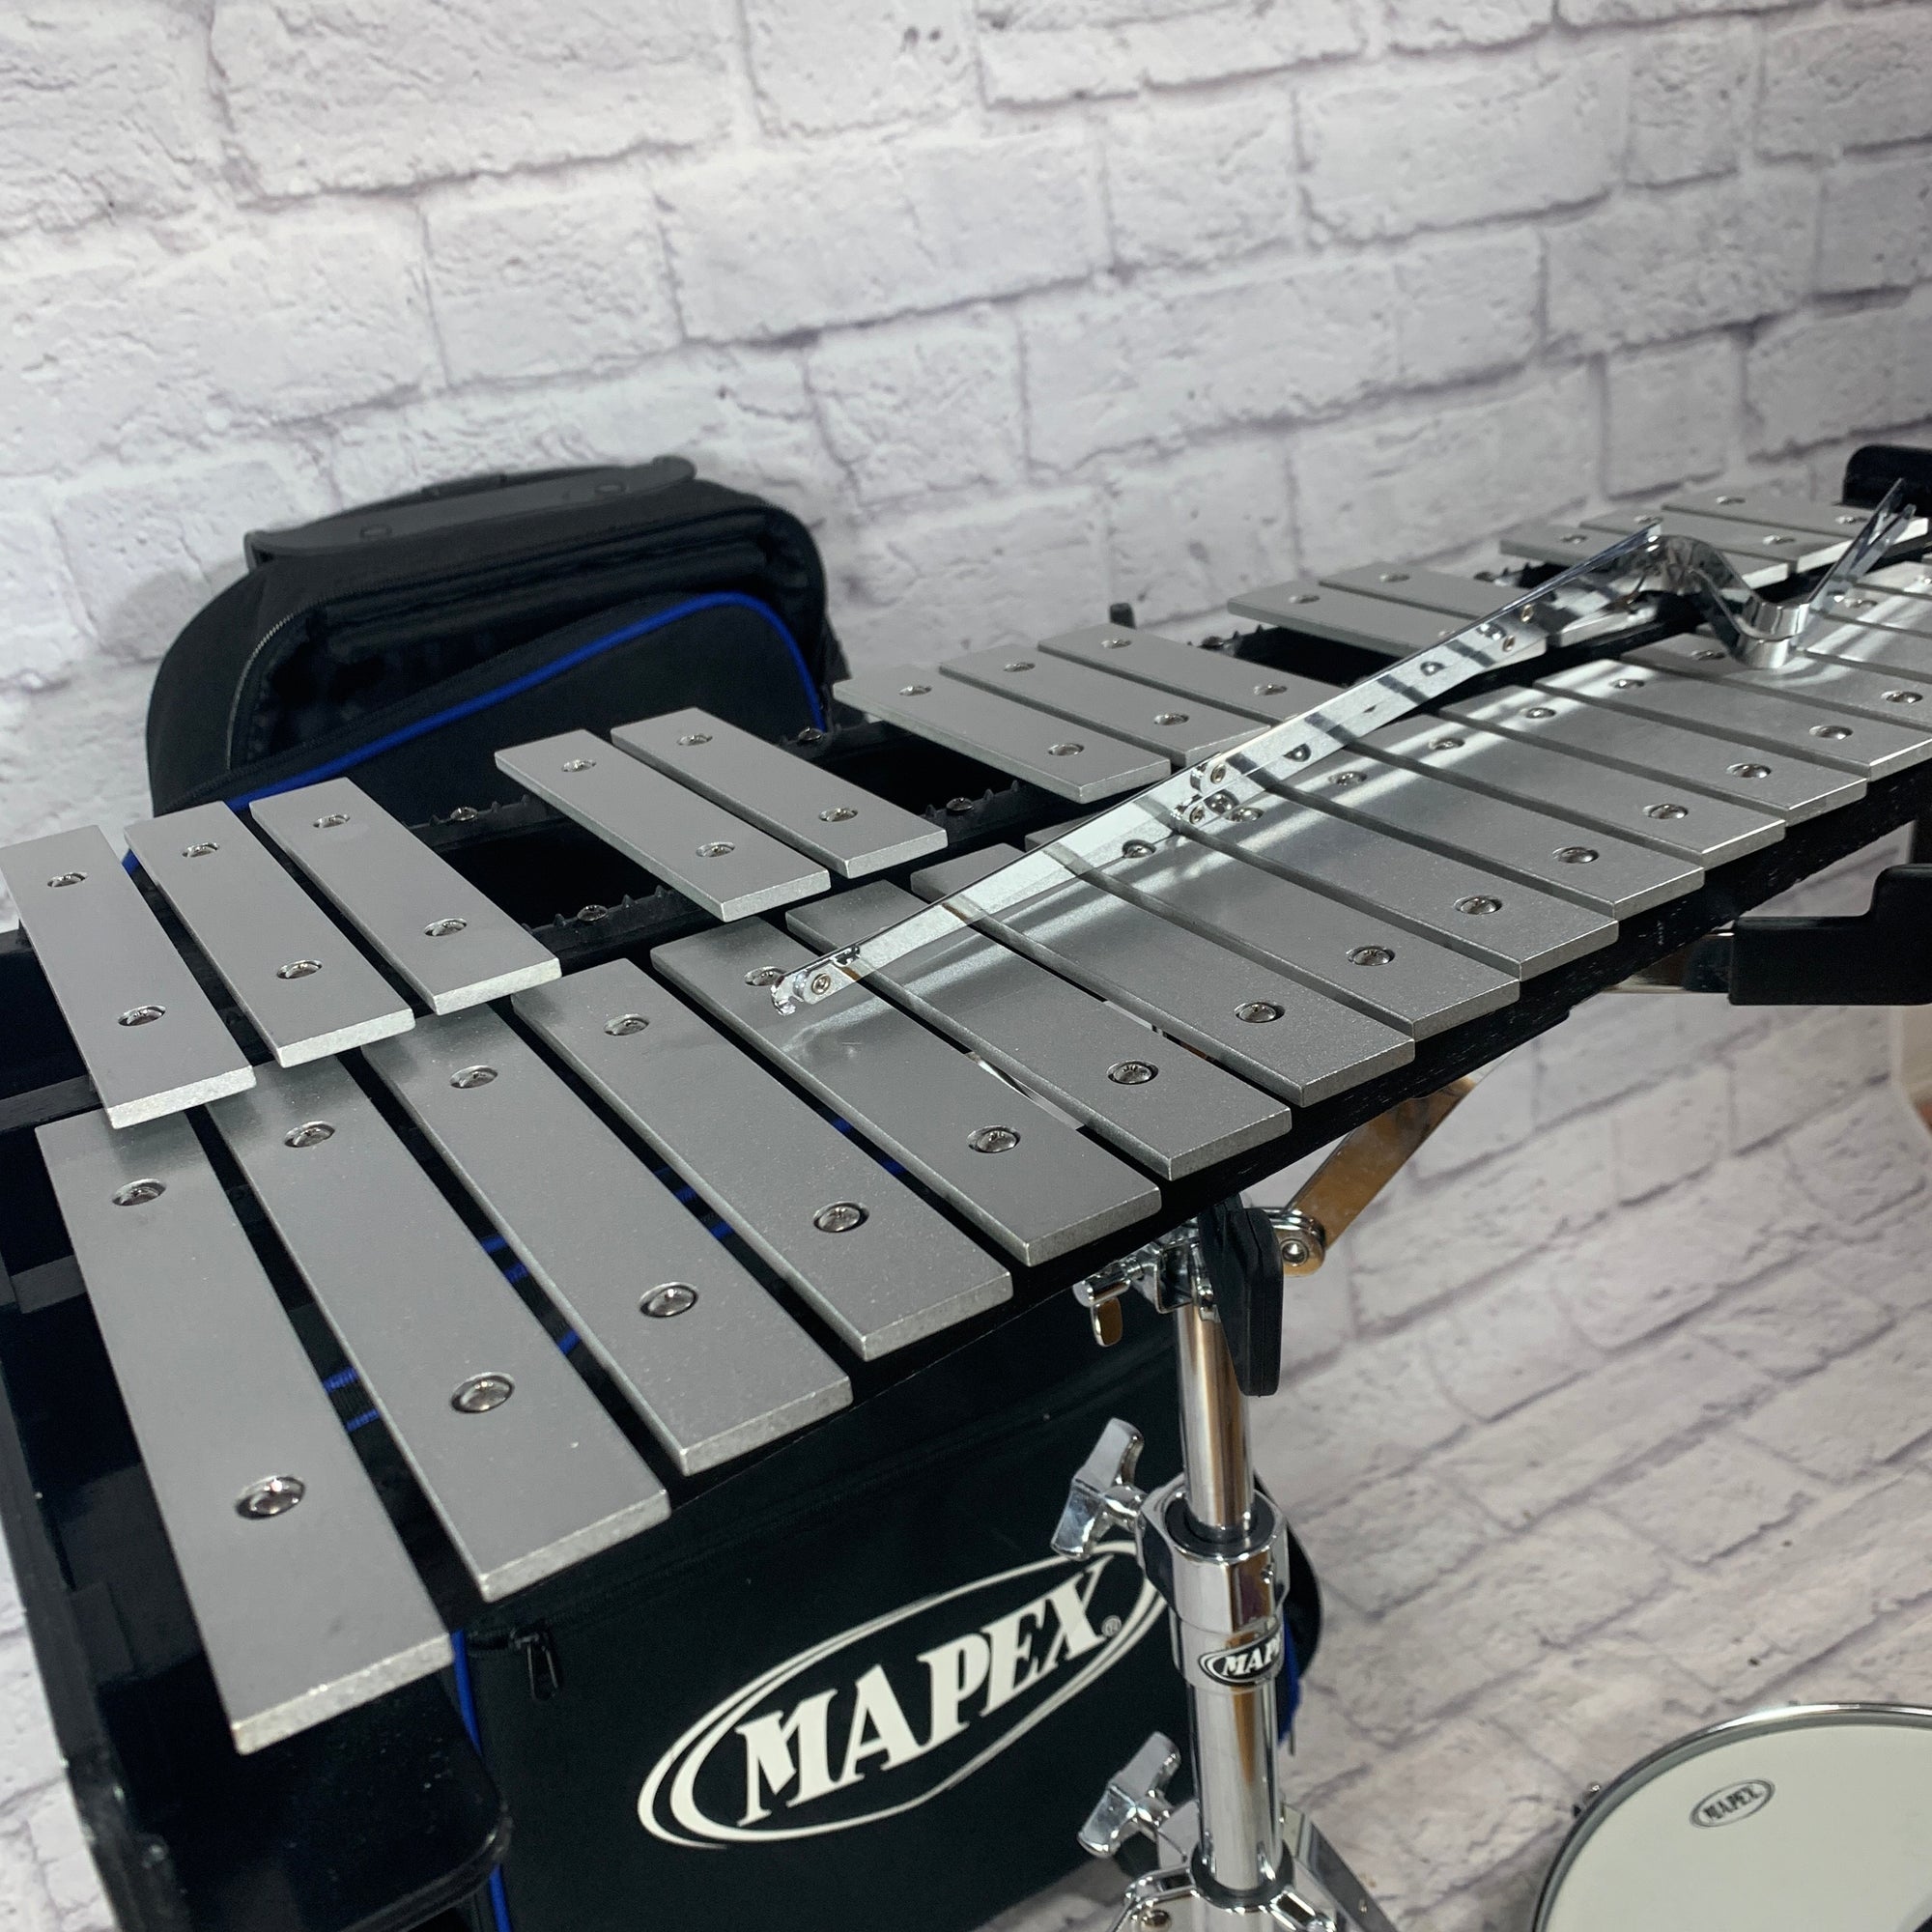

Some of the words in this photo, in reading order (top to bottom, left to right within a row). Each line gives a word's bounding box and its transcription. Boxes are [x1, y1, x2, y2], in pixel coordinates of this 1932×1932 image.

[1221, 1634, 1281, 1676] MAP
[735, 1553, 1116, 1828] MAPEX
[1702, 1785, 1763, 1820] MAPEX
